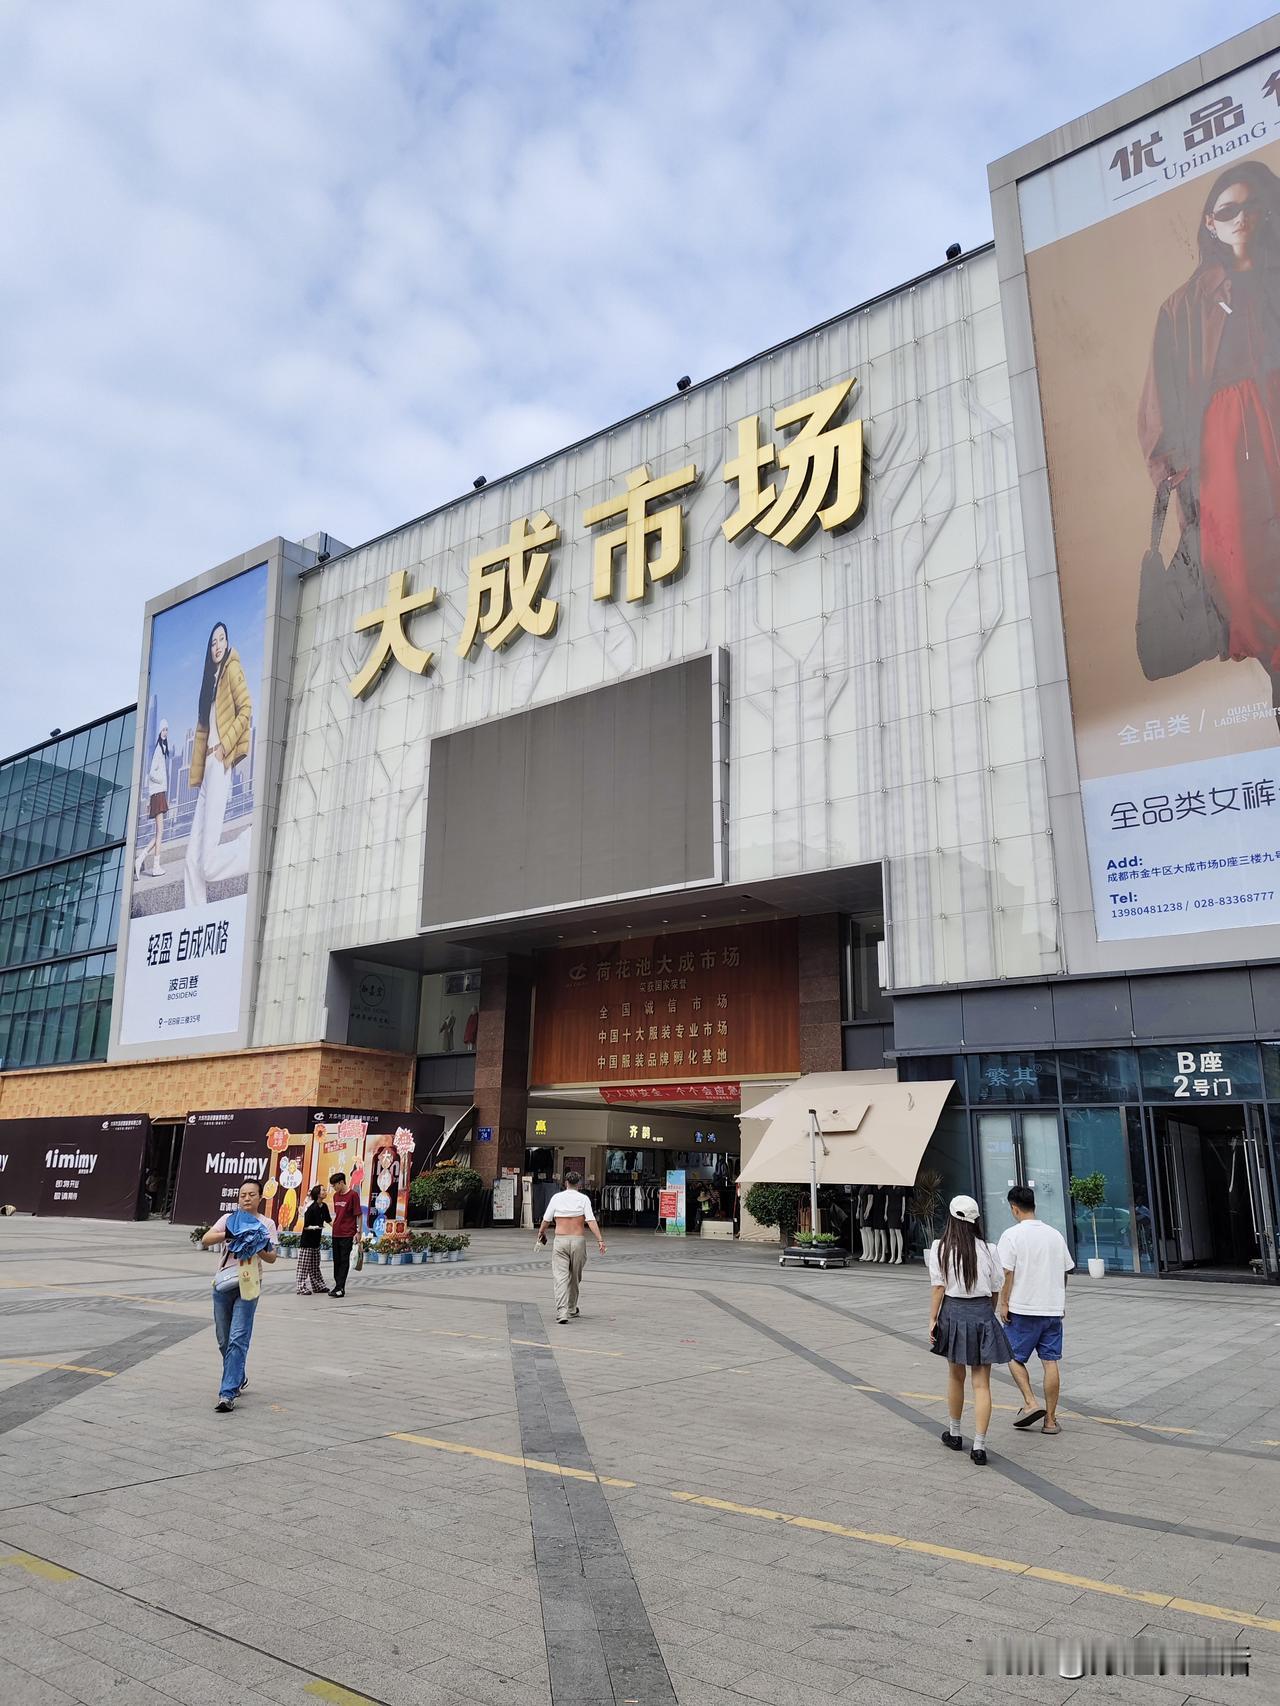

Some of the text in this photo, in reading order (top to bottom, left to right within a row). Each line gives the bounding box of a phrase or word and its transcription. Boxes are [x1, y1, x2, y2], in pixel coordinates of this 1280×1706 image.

[1162, 121, 1267, 180] UpinhanG
[347, 376, 864, 700] 大成市场
[1227, 701, 1268, 717] QUALITY
[1117, 713, 1191, 746] 全品类
[1110, 778, 1280, 830] 全品类女裤
[1106, 855, 1143, 871] Add:
[1109, 891, 1138, 905] Tel:
[1193, 891, 1275, 909] 028-83368777
[146, 919, 230, 967] 轻盈 自成风格
[595, 945, 741, 982] 荷花池大成市场
[168, 975, 200, 992] 波司登
[167, 990, 198, 1001] BOSIDENG
[599, 993, 729, 1020] 全国诚信市场
[598, 1020, 729, 1045] 中国十大服装专业市场
[597, 1048, 728, 1071] 中国服装品牌孵化基地
[1177, 1051, 1224, 1074] B座
[984, 1067, 1038, 1087] 繁其
[1173, 1075, 1233, 1098] 2号门
[205, 1152, 269, 1180] Mimimy
[221, 1187, 240, 1198] 即将开
